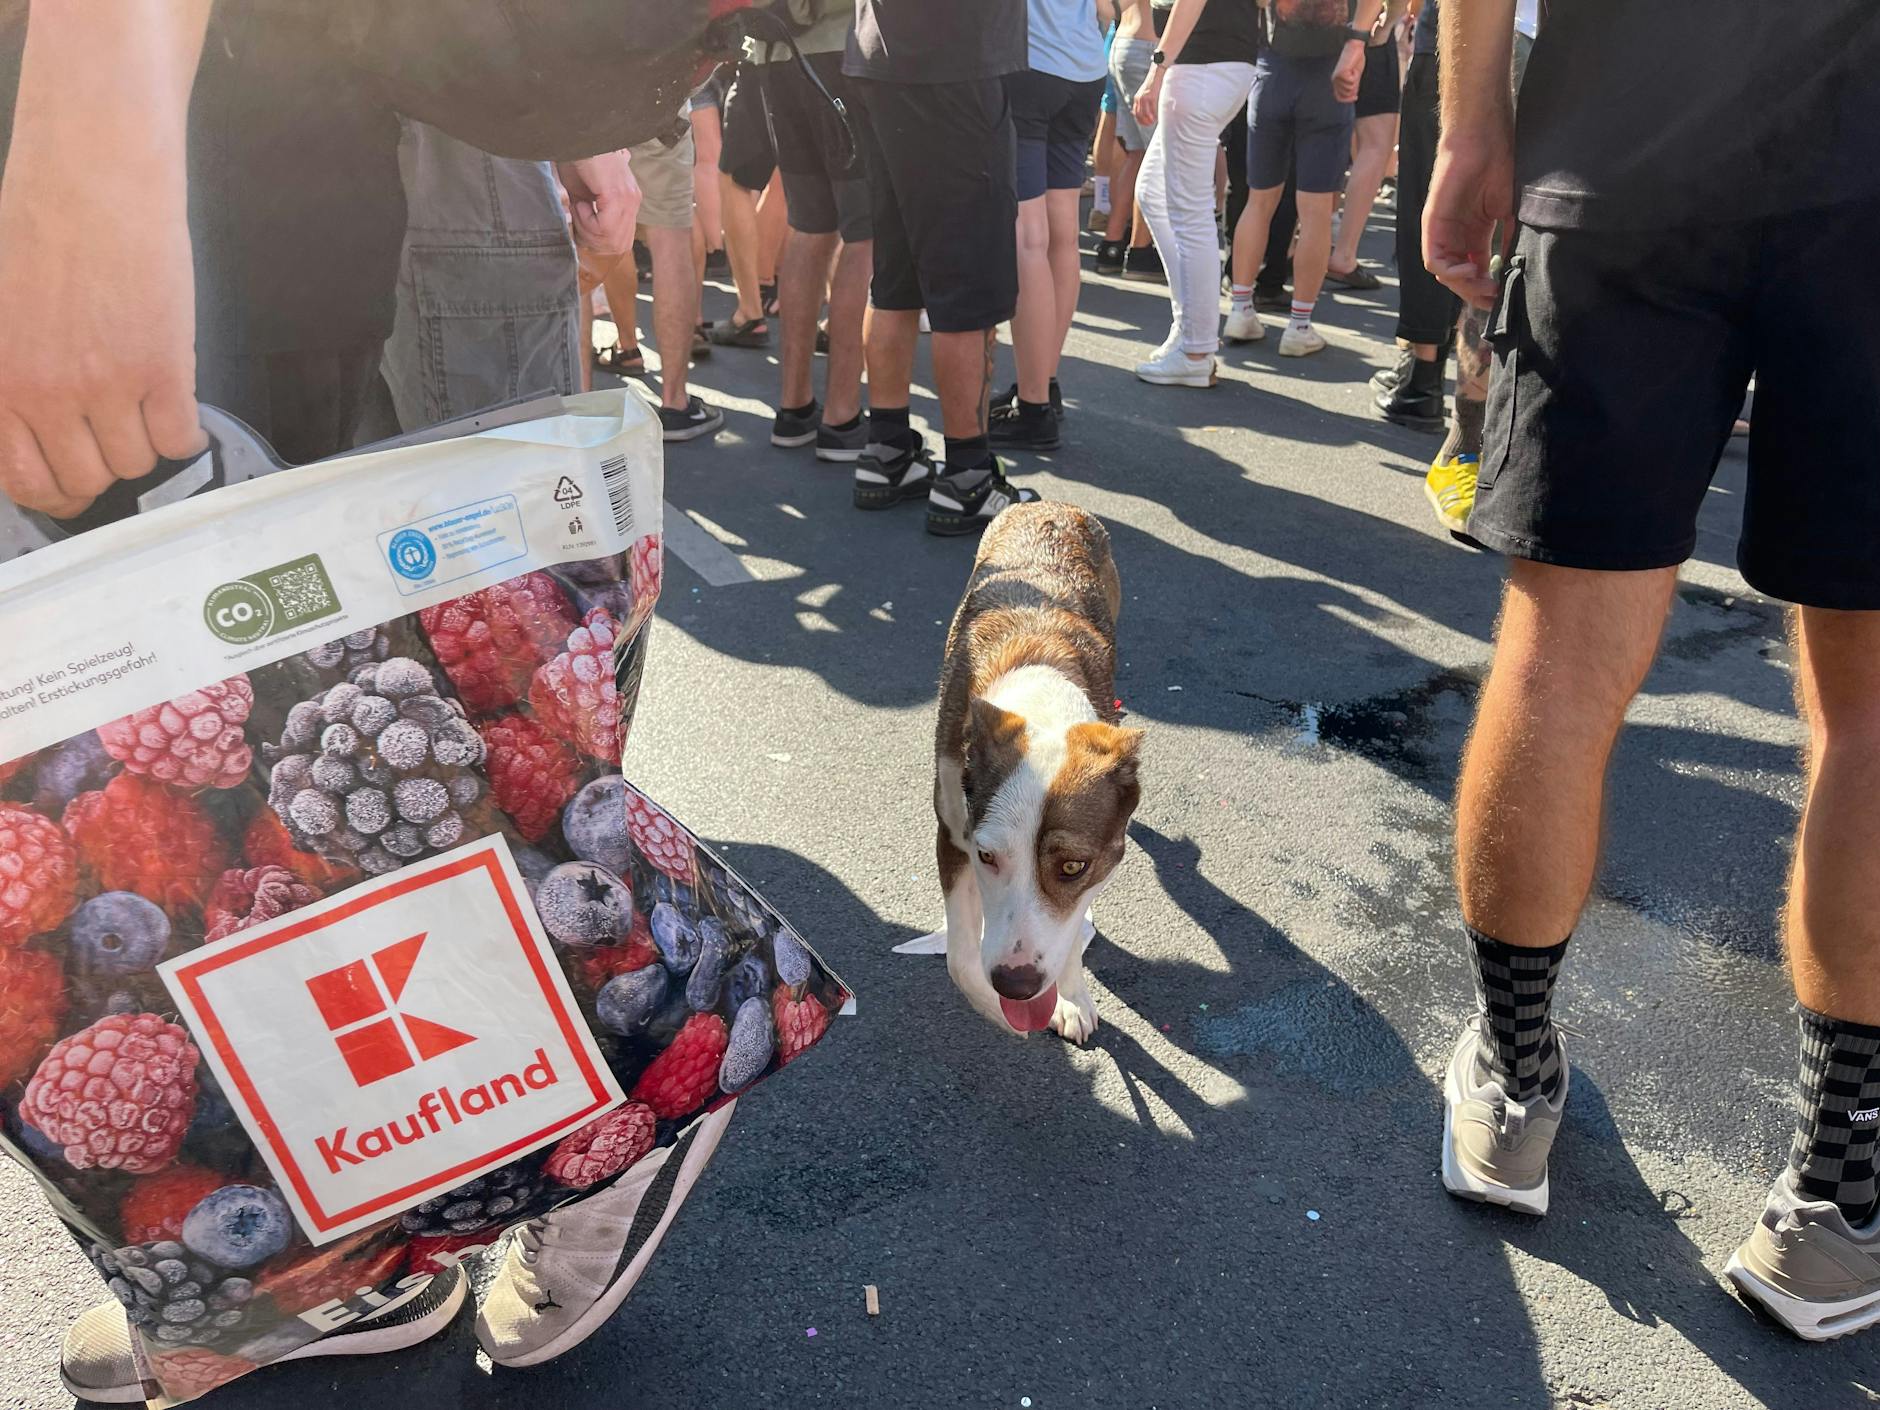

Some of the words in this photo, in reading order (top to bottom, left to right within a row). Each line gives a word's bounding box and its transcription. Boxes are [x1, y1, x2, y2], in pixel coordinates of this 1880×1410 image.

[560, 501, 581, 510] LDPE
[562, 487, 573, 495] 04
[36, 669, 66, 687] Kein
[66, 641, 136, 675] Spielzeug!
[0, 696, 37, 720] alten!
[38, 651, 158, 705] Erstickungsgefahr!
[314, 1048, 558, 1174] Kaufland
[1847, 1107, 1879, 1121] VANS
